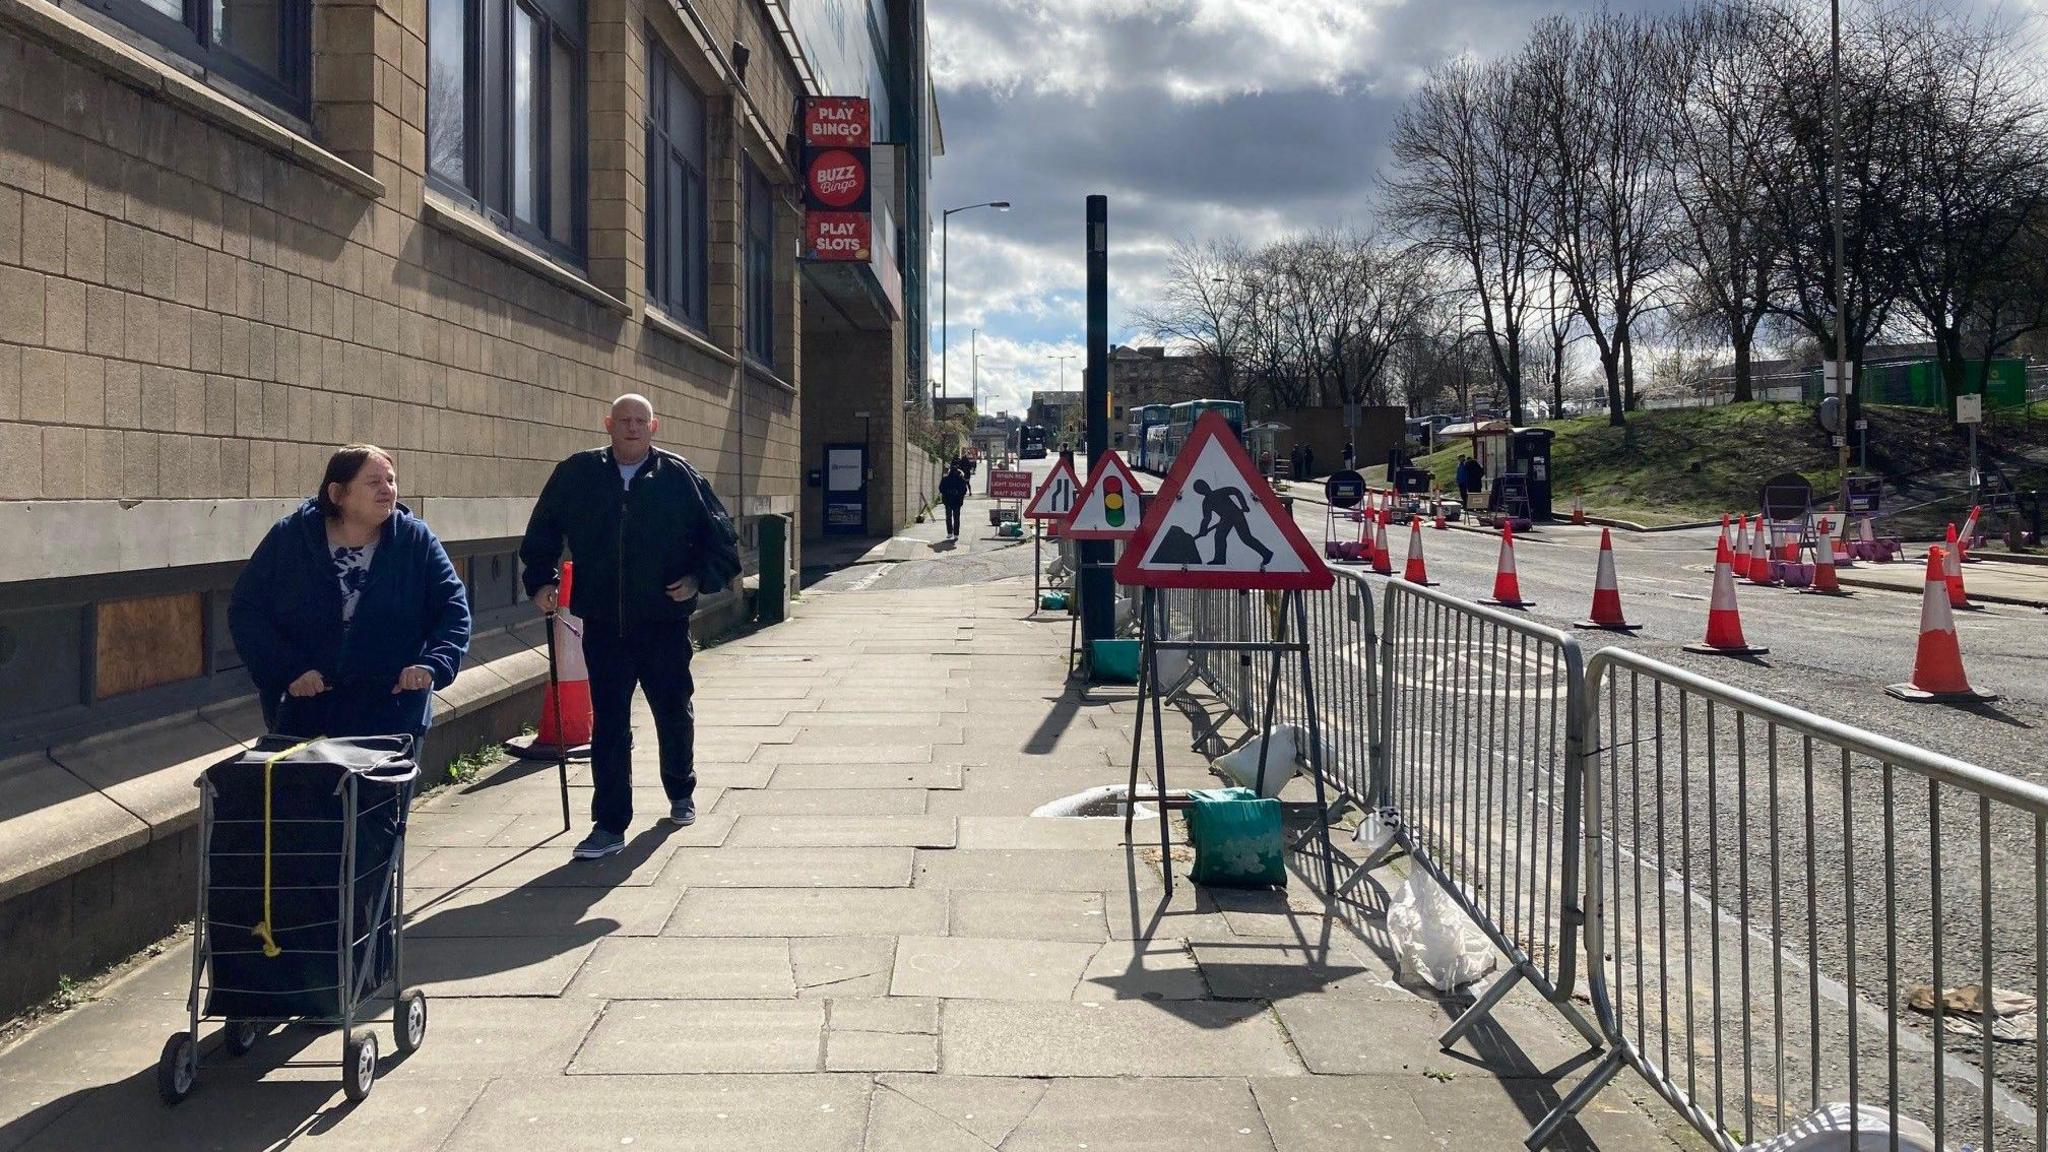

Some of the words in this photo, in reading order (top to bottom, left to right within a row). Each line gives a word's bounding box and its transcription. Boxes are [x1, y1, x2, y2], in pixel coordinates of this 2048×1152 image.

[819, 108, 855, 120] PLAY
[812, 123, 862, 136] BINGO
[817, 165, 856, 183] BUZZ
[820, 180, 858, 194] Bingo
[820, 223, 856, 235] PLAY
[816, 238, 860, 251] SLOTS
[996, 472, 1014, 480] WHEN
